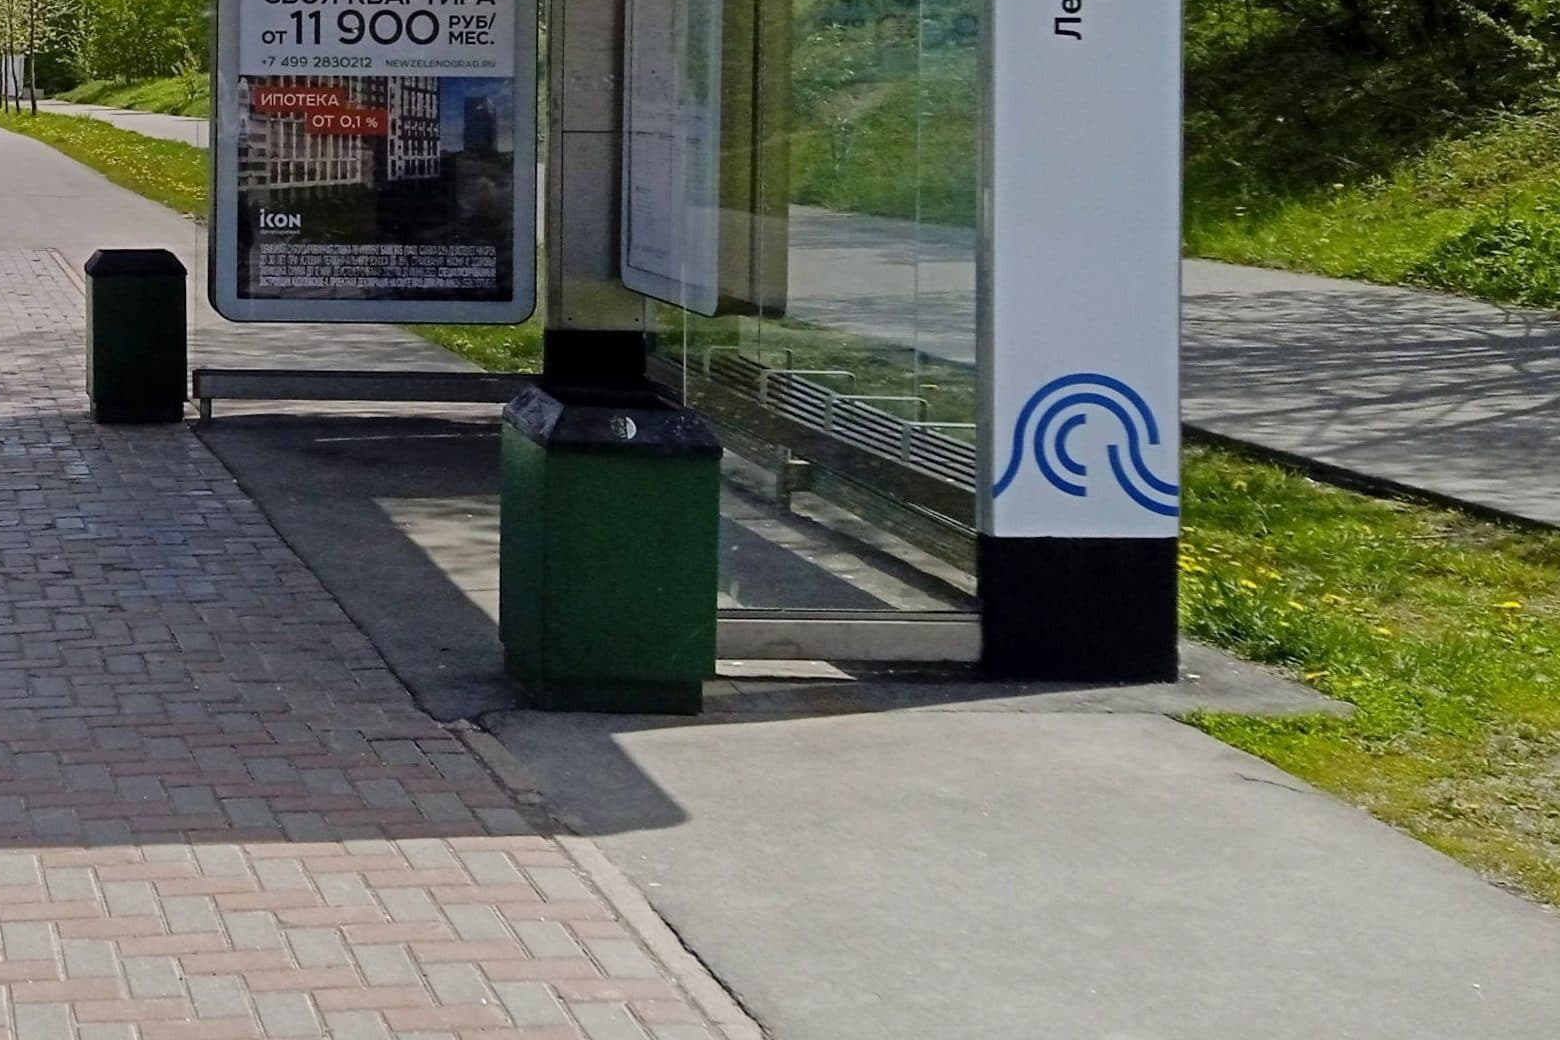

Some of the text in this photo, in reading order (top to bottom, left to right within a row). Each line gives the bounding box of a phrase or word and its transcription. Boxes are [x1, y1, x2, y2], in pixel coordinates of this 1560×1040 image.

[290, 10, 321, 45] 11
[337, 9, 440, 46] 900
[448, 13, 496, 30] РУБ/
[448, 31, 495, 46] МЕС.
[261, 57, 276, 68] +7
[280, 57, 308, 68] 499
[313, 57, 372, 68] 2830212
[260, 93, 340, 107] ИПОТЕКА
[312, 115, 378, 128] ОТ 0,1 %
